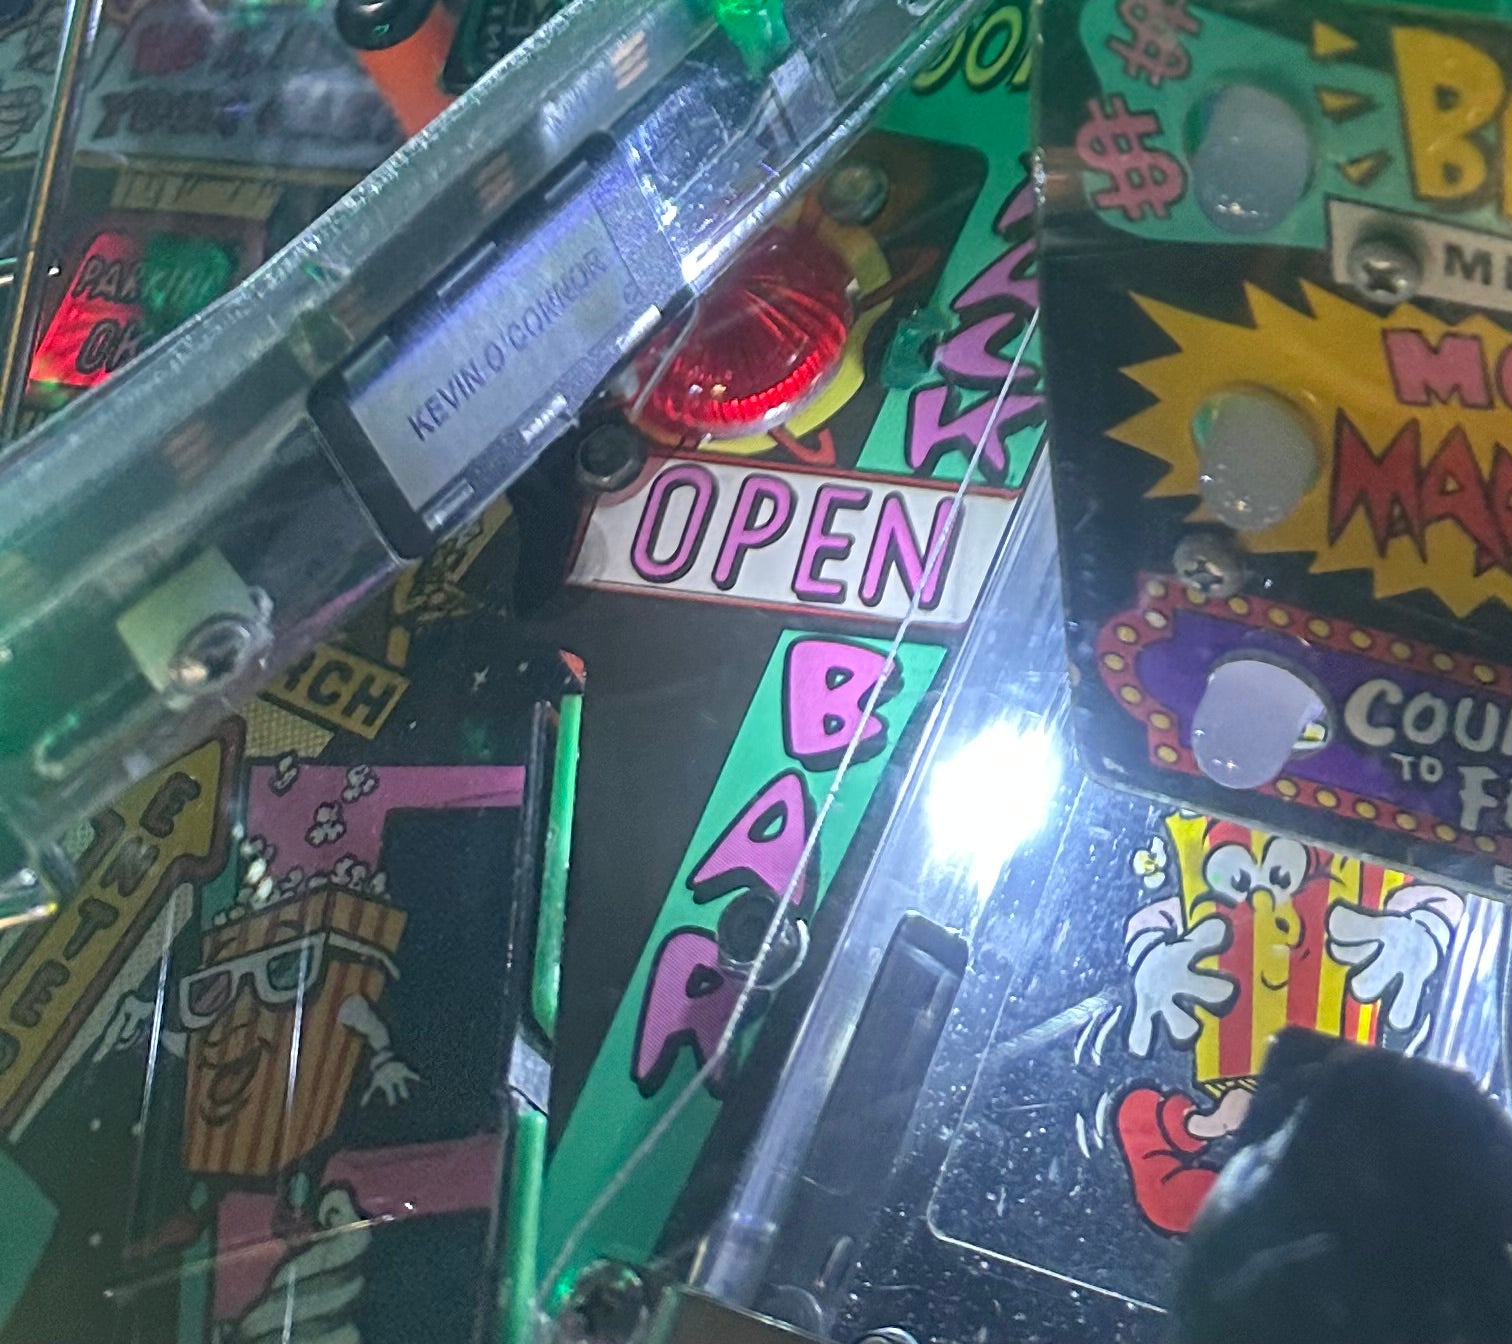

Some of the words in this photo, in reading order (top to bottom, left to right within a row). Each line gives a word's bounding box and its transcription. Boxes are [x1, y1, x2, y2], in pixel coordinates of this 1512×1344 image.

[405, 356, 488, 443] KEVIN
[629, 462, 967, 609] OPEN
[1389, 751, 1444, 785] TO
[629, 634, 905, 1100] BAR
